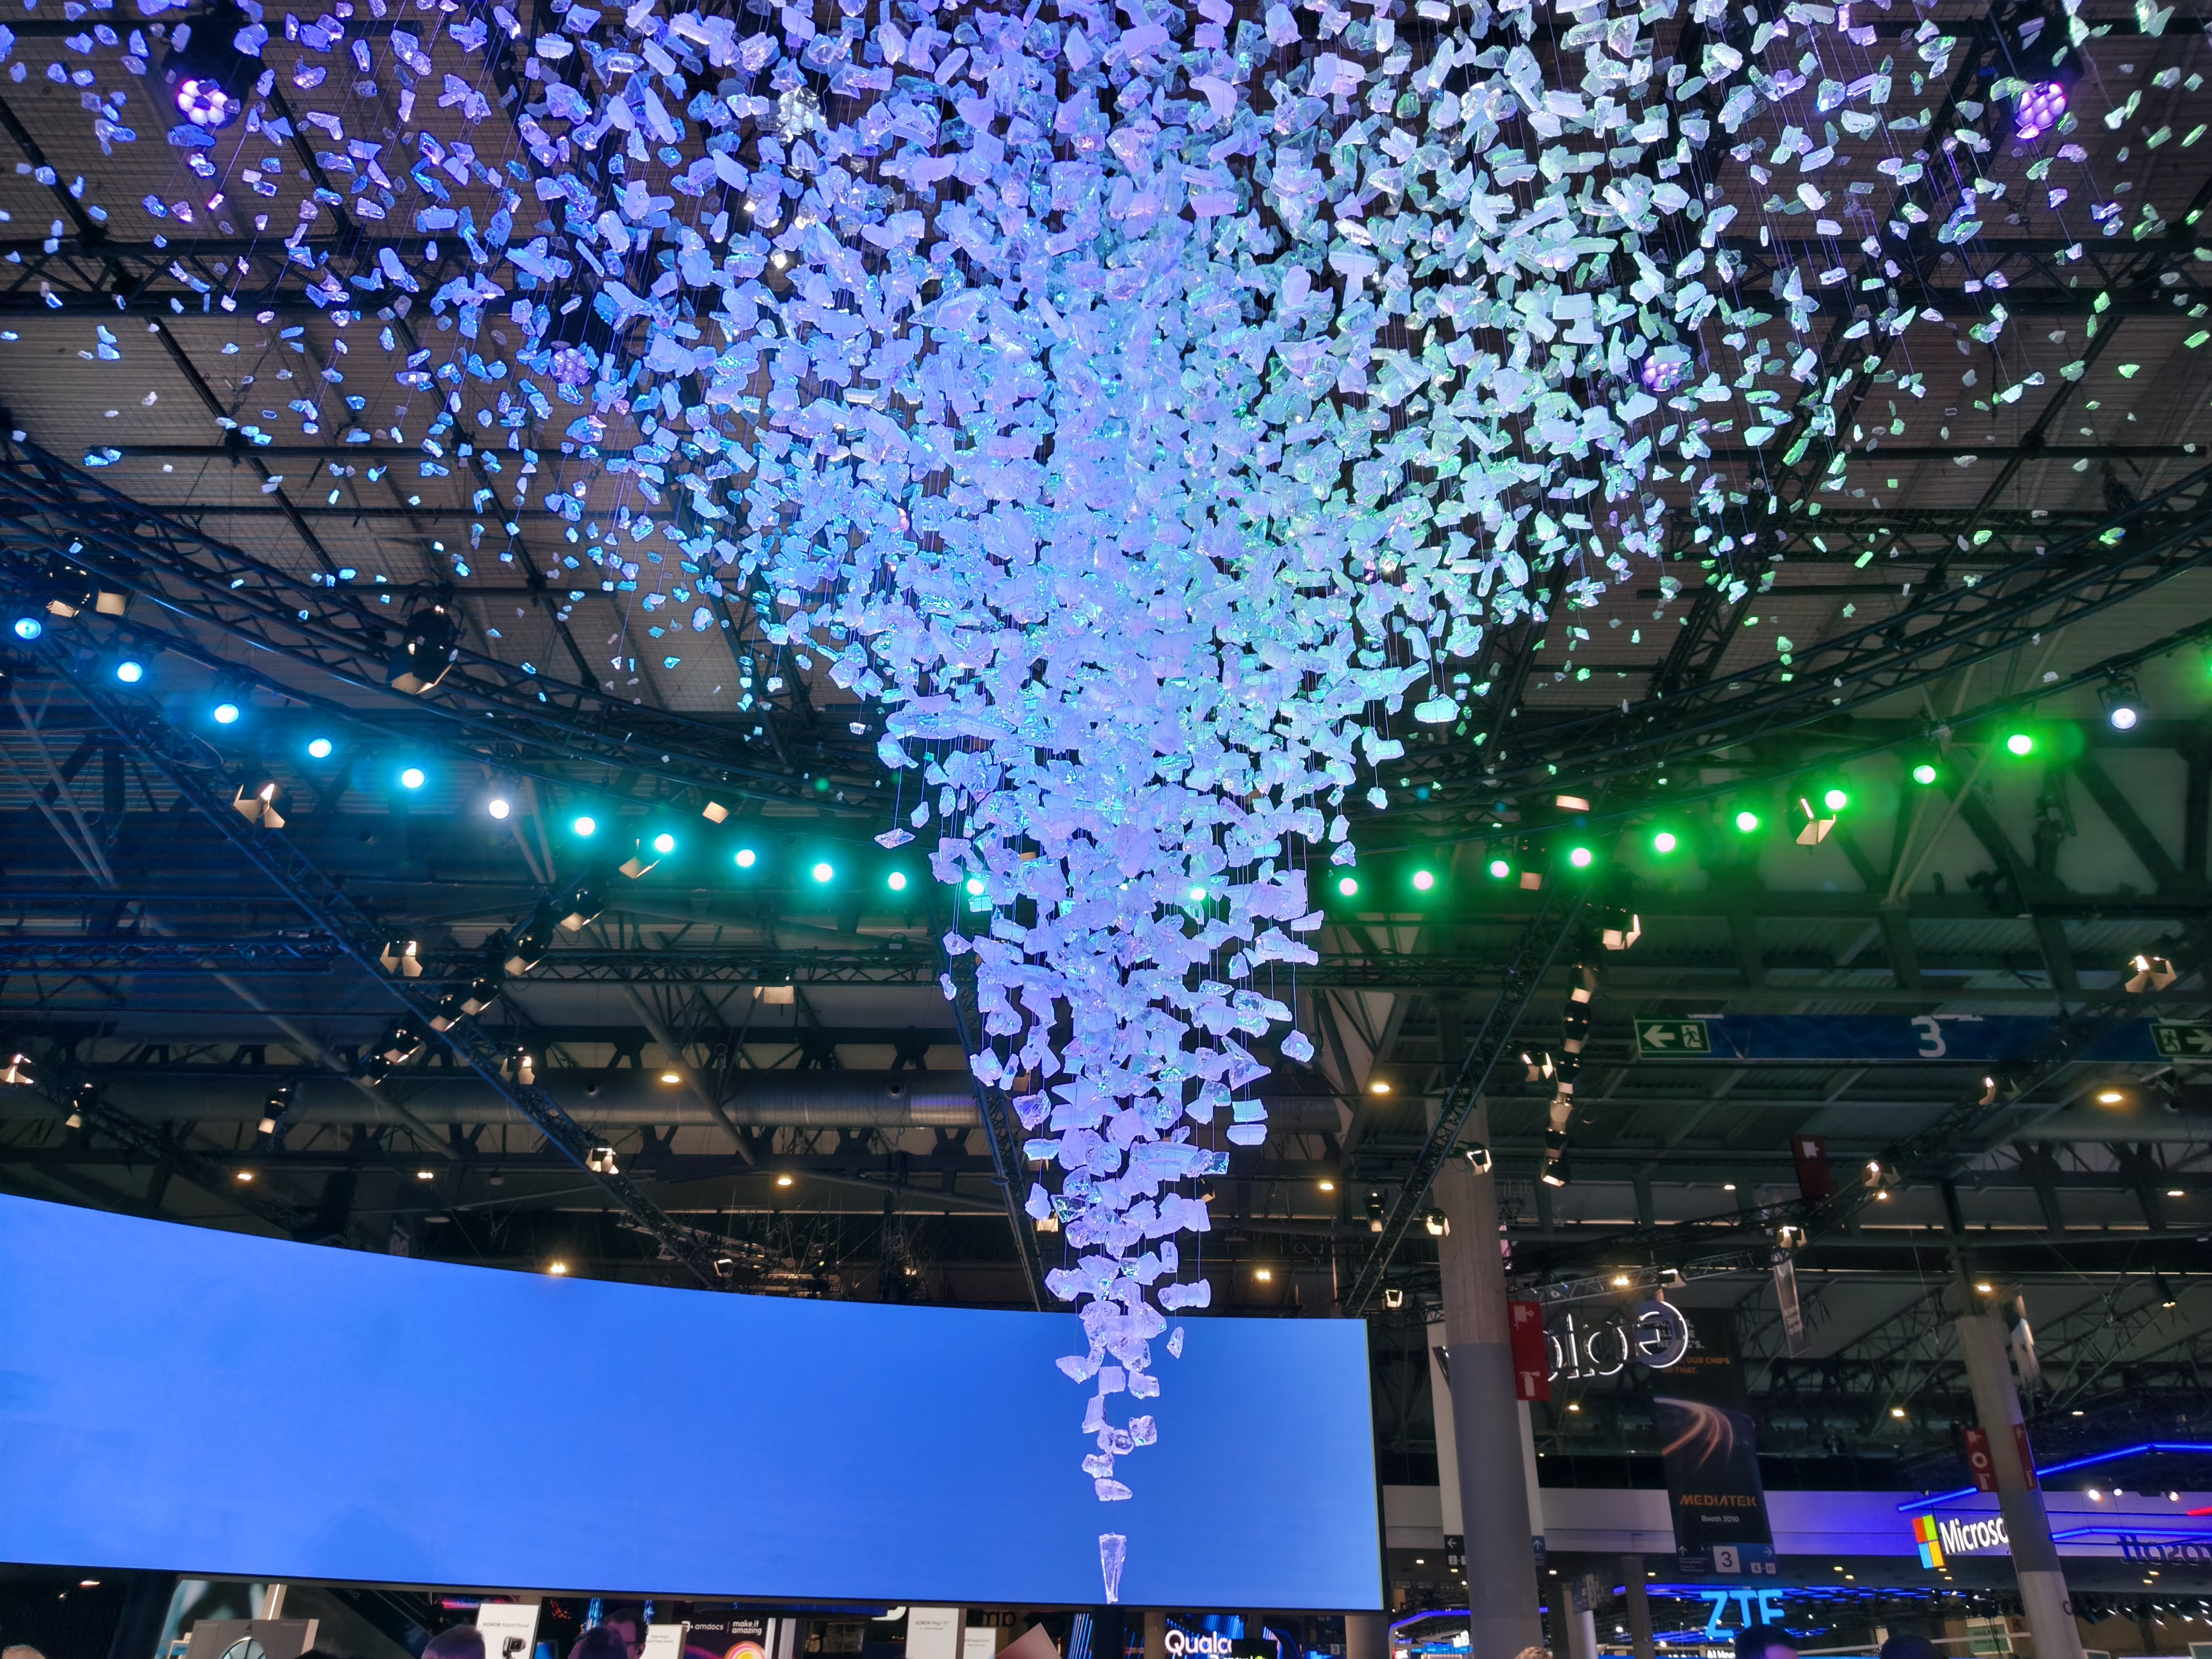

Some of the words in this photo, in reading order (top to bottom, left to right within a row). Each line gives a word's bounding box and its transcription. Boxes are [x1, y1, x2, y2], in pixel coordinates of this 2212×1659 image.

[1911, 1016, 1946, 1057] 3
[1680, 1494, 1757, 1507] MEDIATEK
[1721, 1552, 1733, 1567] 3
[754, 1619, 759, 1627] it
[732, 1626, 762, 1635] amazing
